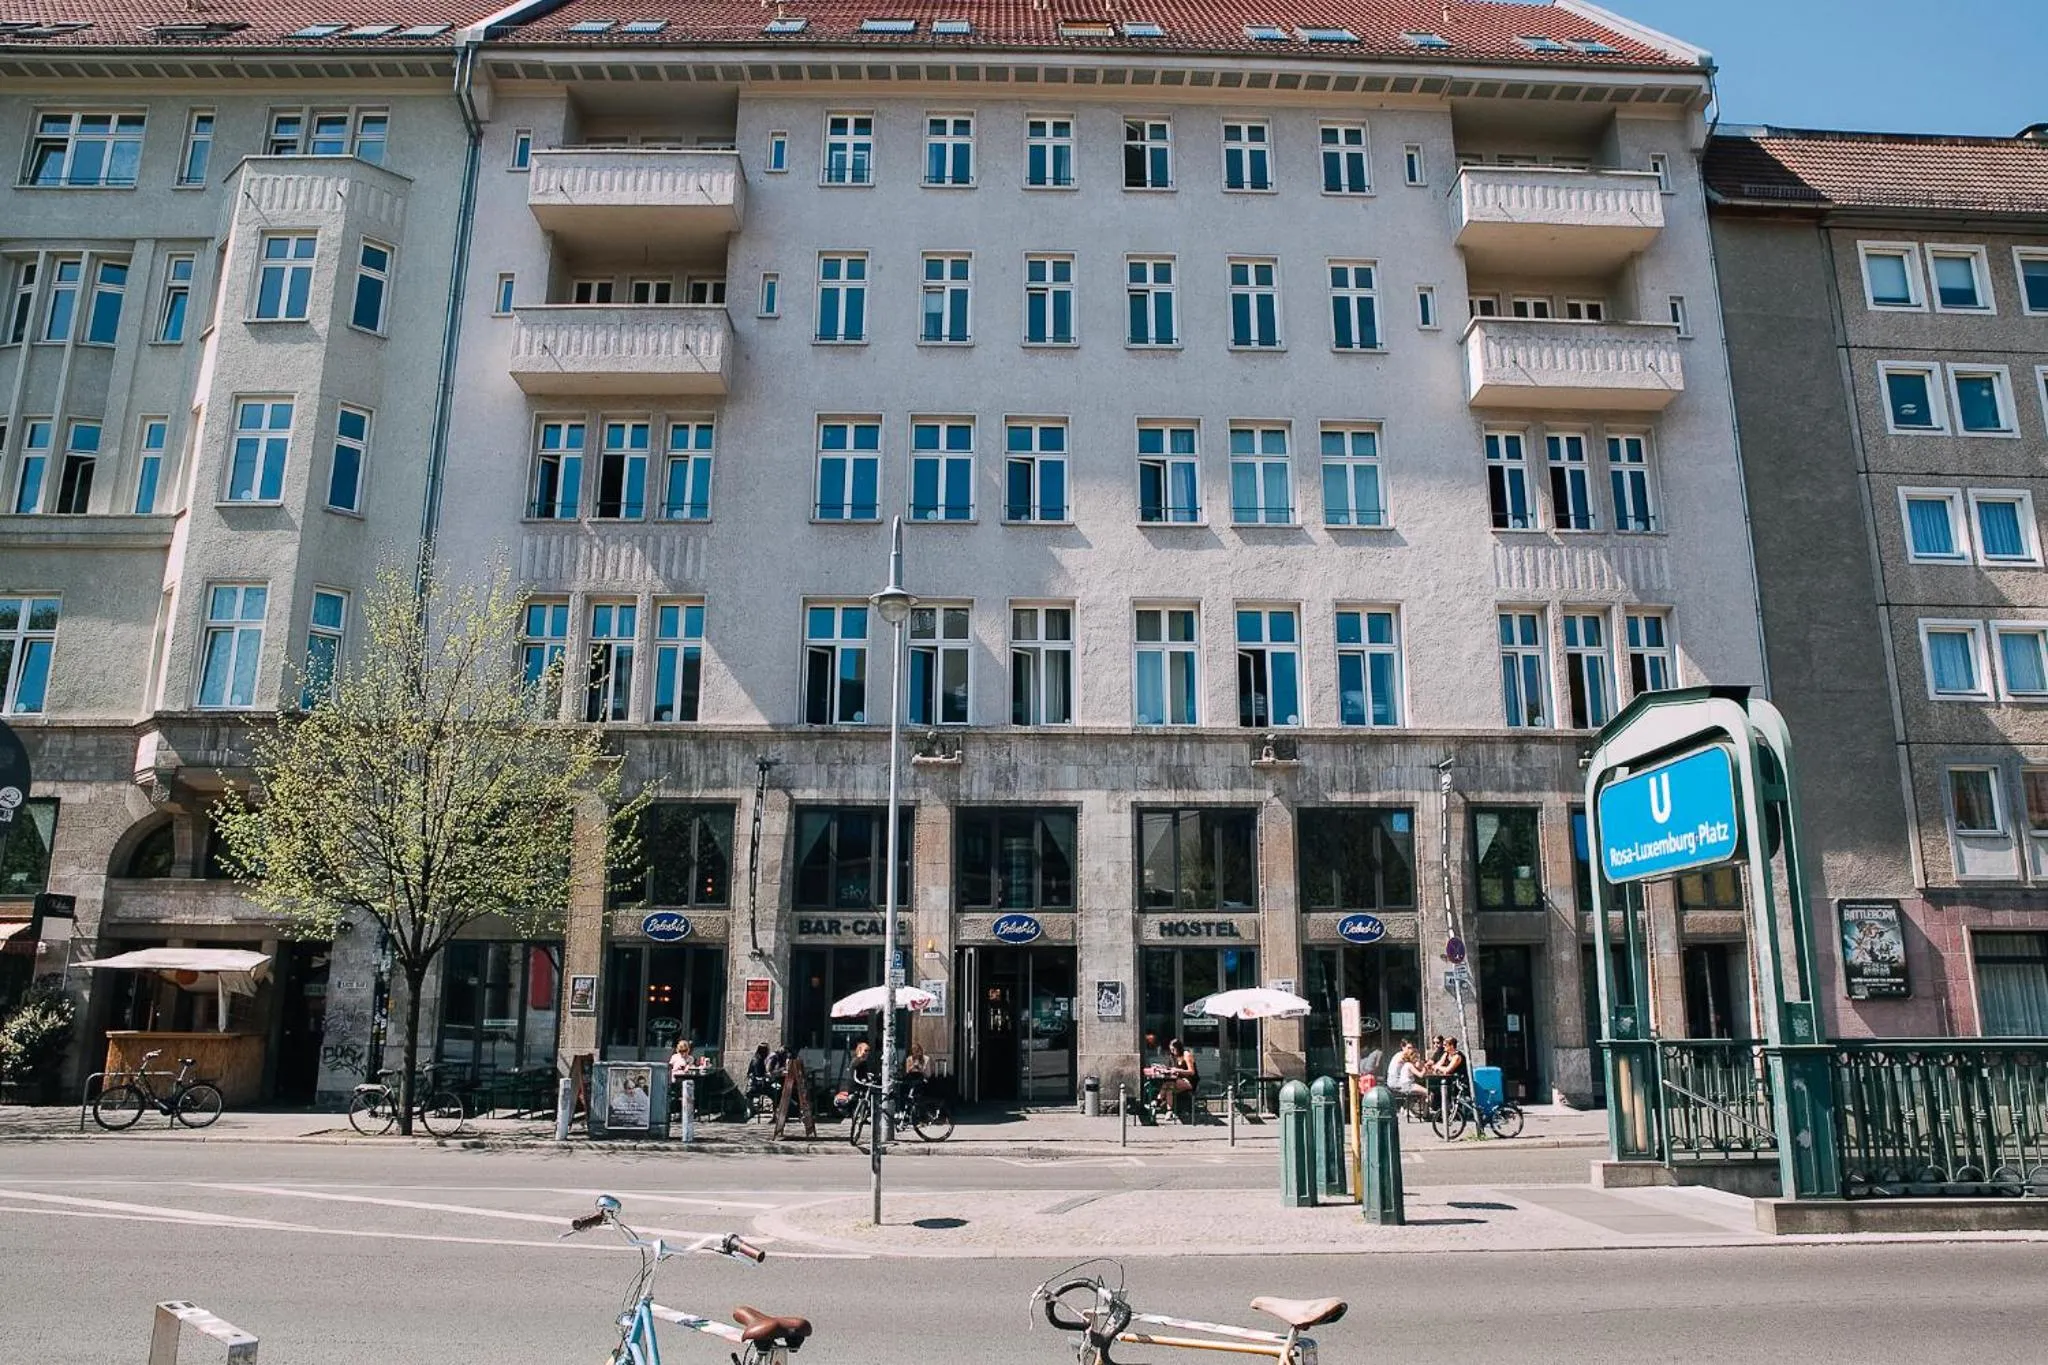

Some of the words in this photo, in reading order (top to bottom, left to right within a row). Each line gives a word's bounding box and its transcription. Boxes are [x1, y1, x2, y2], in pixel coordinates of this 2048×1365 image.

[1648, 772, 1672, 824] U
[1609, 821, 1730, 867] Rosa-Luxemburg-Platz
[798, 919, 906, 936] BAR-CAE
[1159, 920, 1242, 937] HOSTEL
